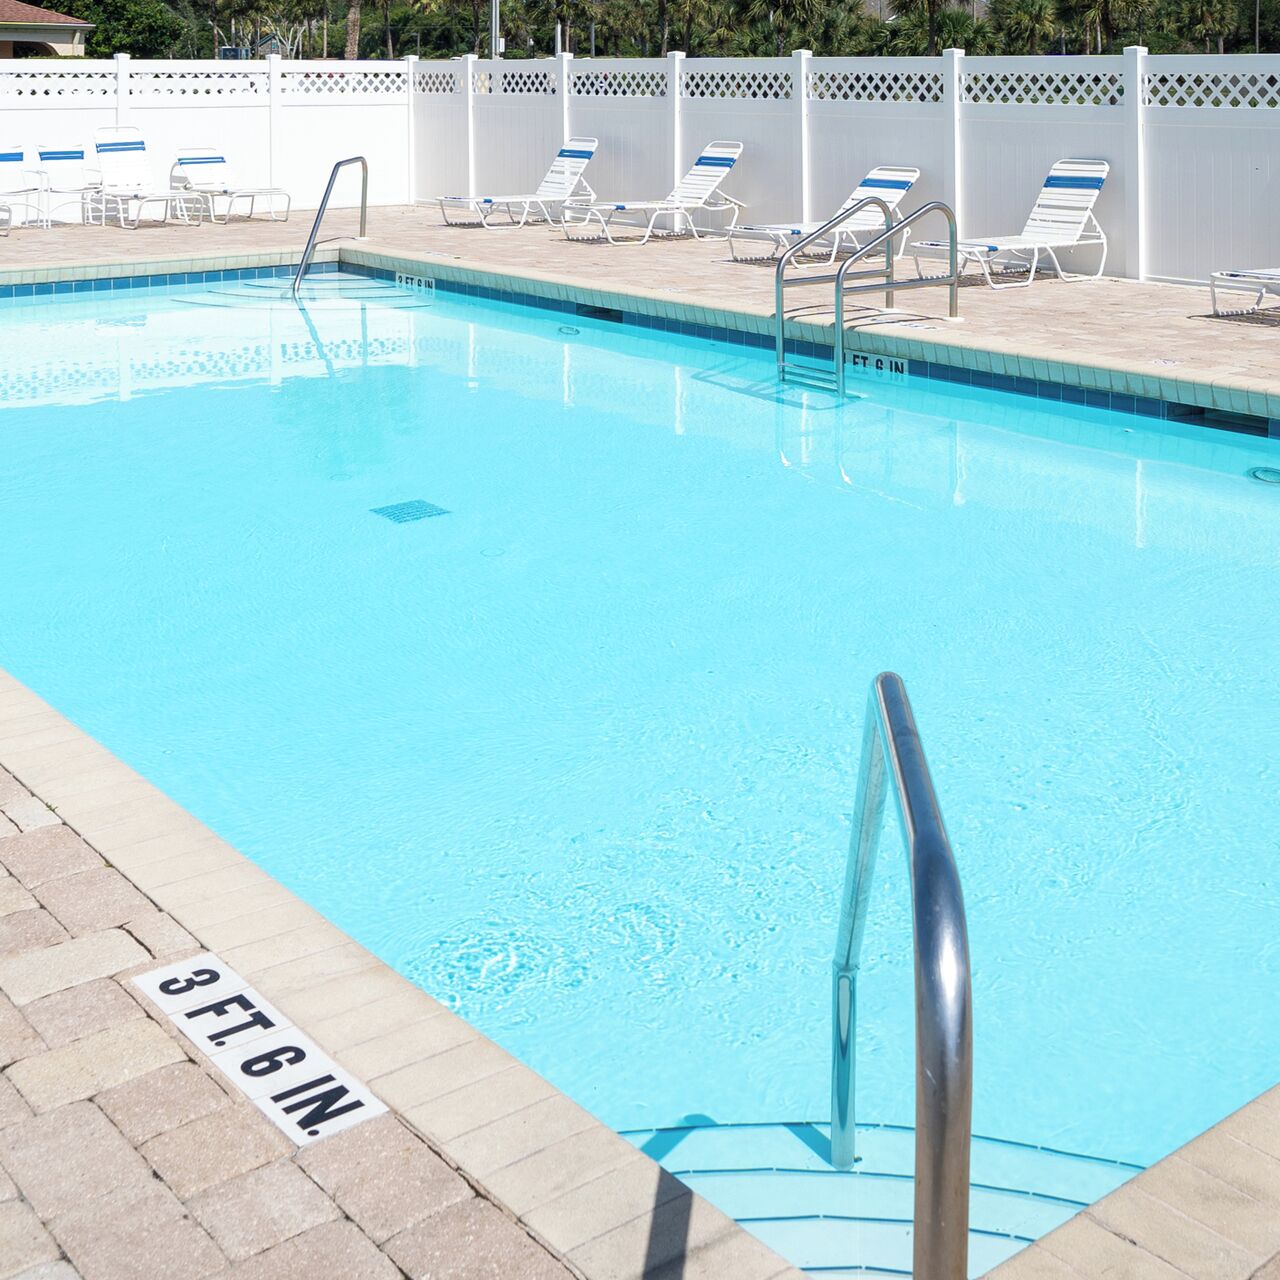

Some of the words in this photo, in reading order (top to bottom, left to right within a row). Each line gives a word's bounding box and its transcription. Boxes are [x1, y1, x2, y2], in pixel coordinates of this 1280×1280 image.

[853, 354, 868, 367] FT
[890, 360, 904, 374] IN
[158, 968, 221, 996] 3
[183, 993, 277, 1047] FT.
[240, 1045, 307, 1078] 6
[269, 1073, 366, 1137] IN.
